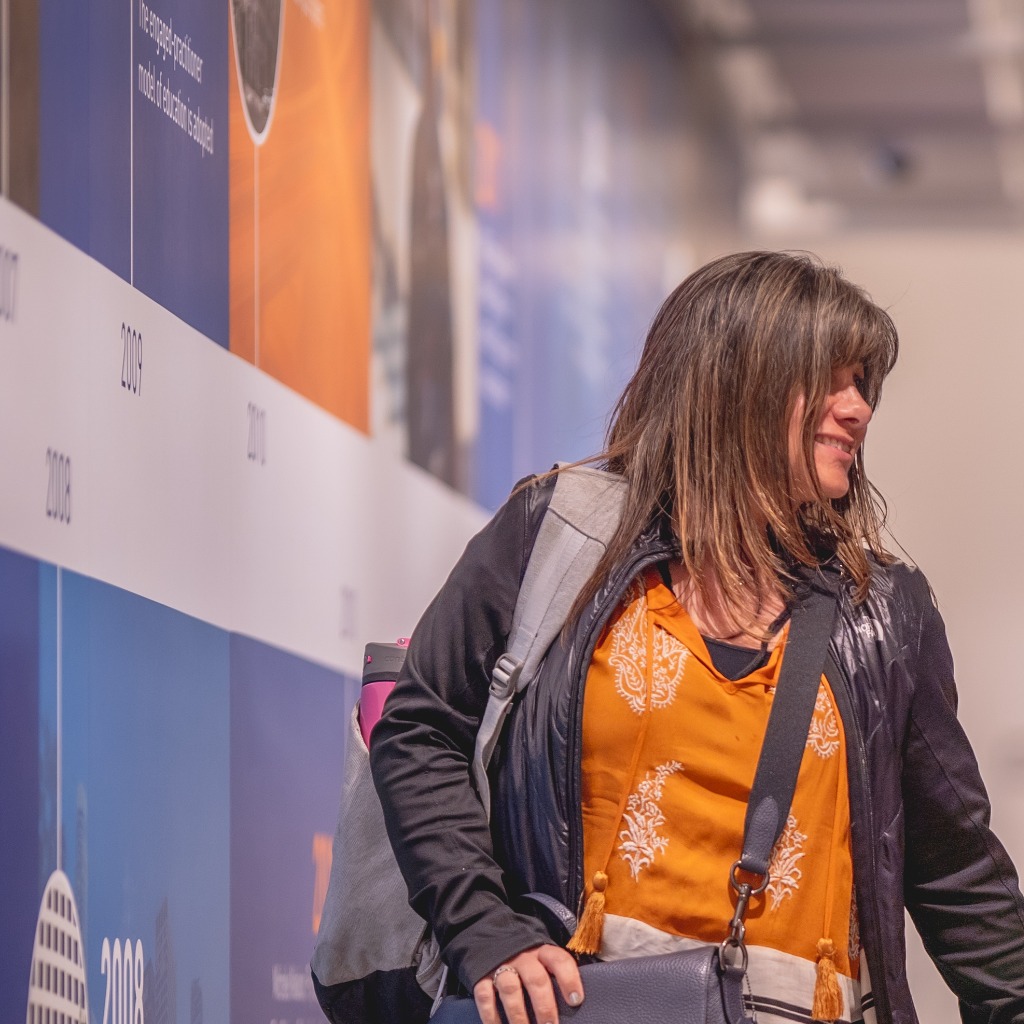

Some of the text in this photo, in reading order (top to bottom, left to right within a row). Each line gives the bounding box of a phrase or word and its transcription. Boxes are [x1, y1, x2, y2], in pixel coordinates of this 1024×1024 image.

[138, 60, 213, 158] model of education is adopted
[120, 321, 142, 397] 2009
[45, 447, 71, 525] 2008
